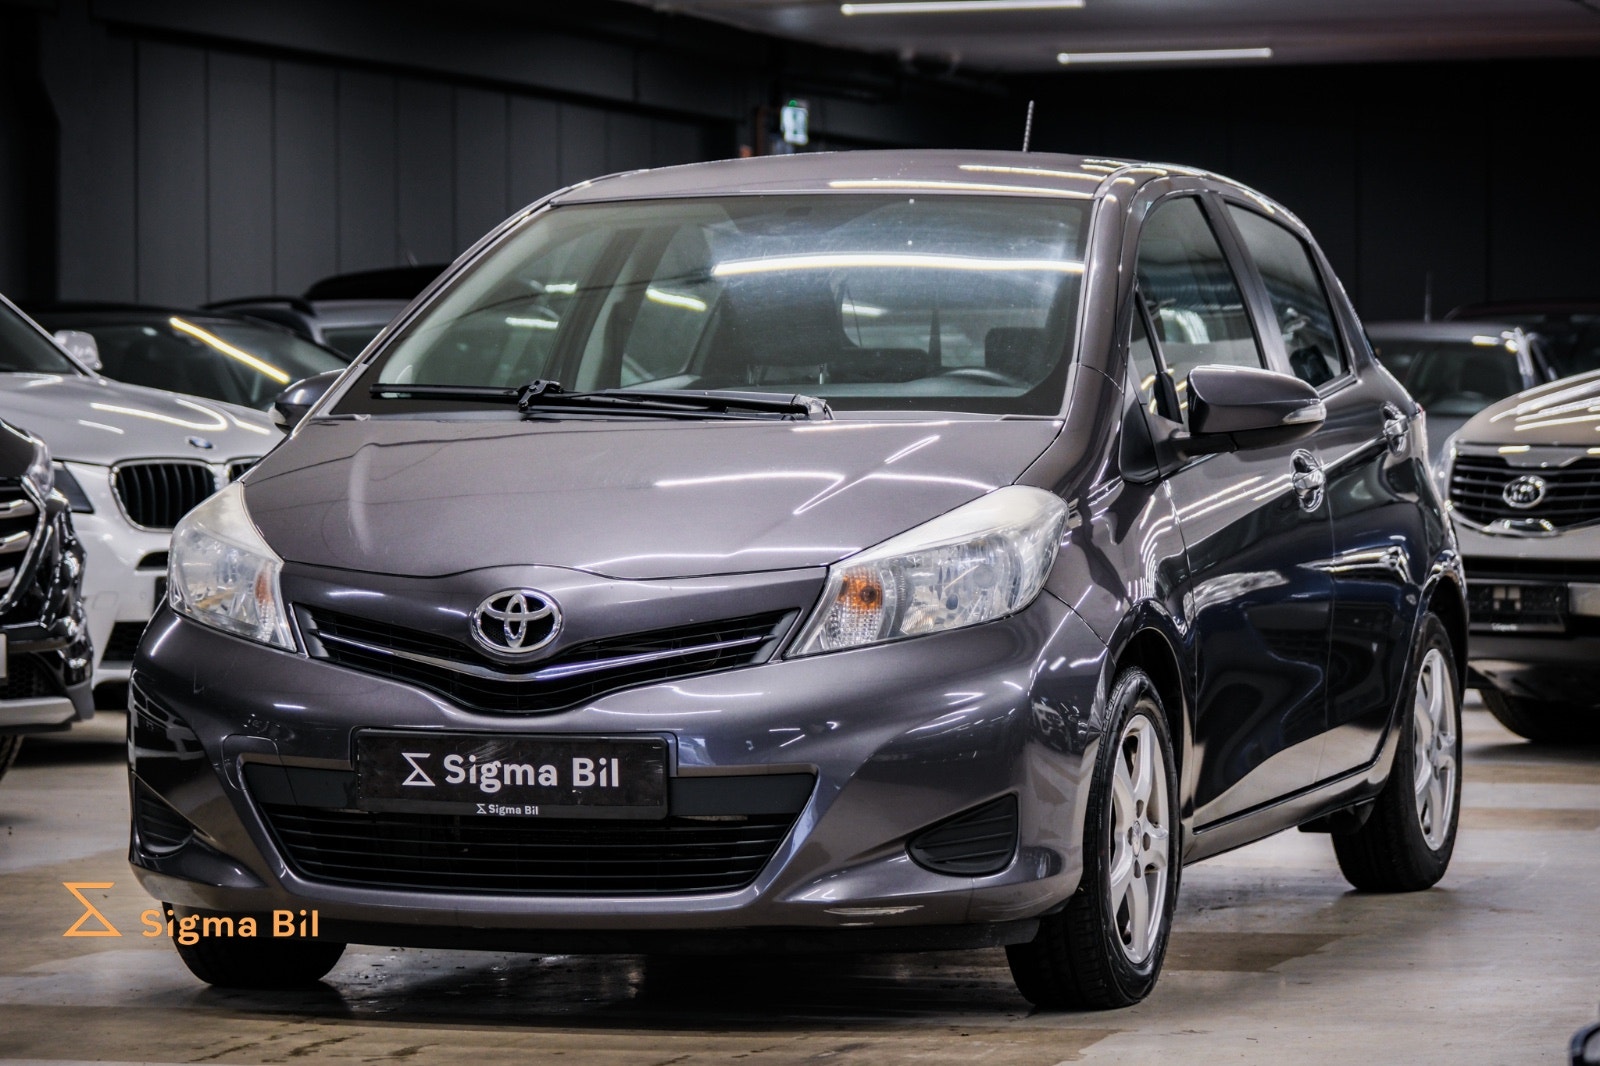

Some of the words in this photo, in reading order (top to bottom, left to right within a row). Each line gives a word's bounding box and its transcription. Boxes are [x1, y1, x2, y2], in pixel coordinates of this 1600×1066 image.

[443, 754, 558, 793] Sigma
[572, 757, 619, 787] Bil
[488, 804, 522, 816] Sigma
[524, 805, 539, 816] Bil
